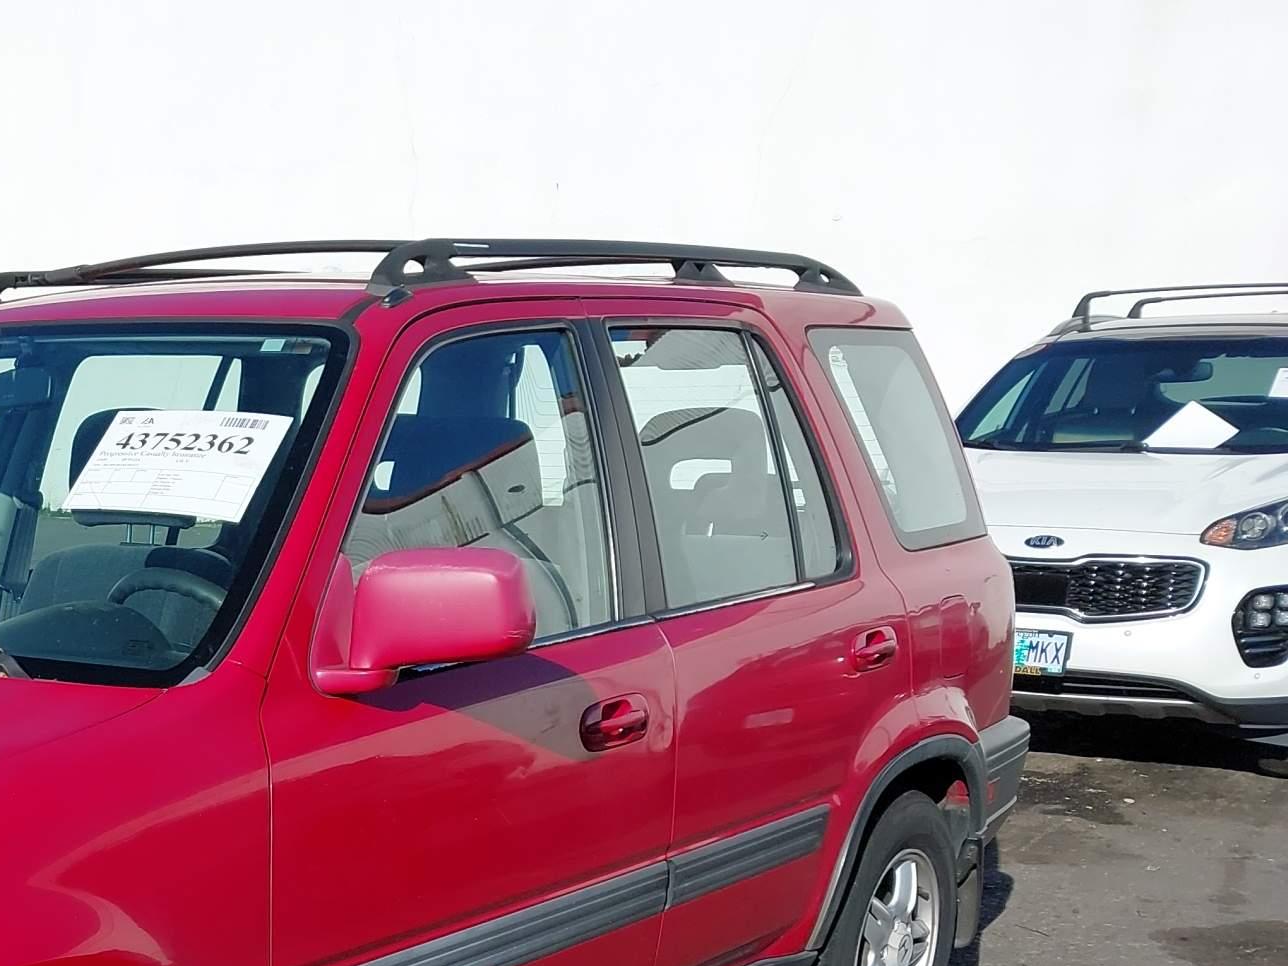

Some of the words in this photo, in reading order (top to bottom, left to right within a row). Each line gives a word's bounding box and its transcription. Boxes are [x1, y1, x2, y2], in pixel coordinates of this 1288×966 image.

[115, 431, 256, 456] 43752362
[1030, 536, 1058, 546] KIA
[1026, 640, 1065, 665] MKX
